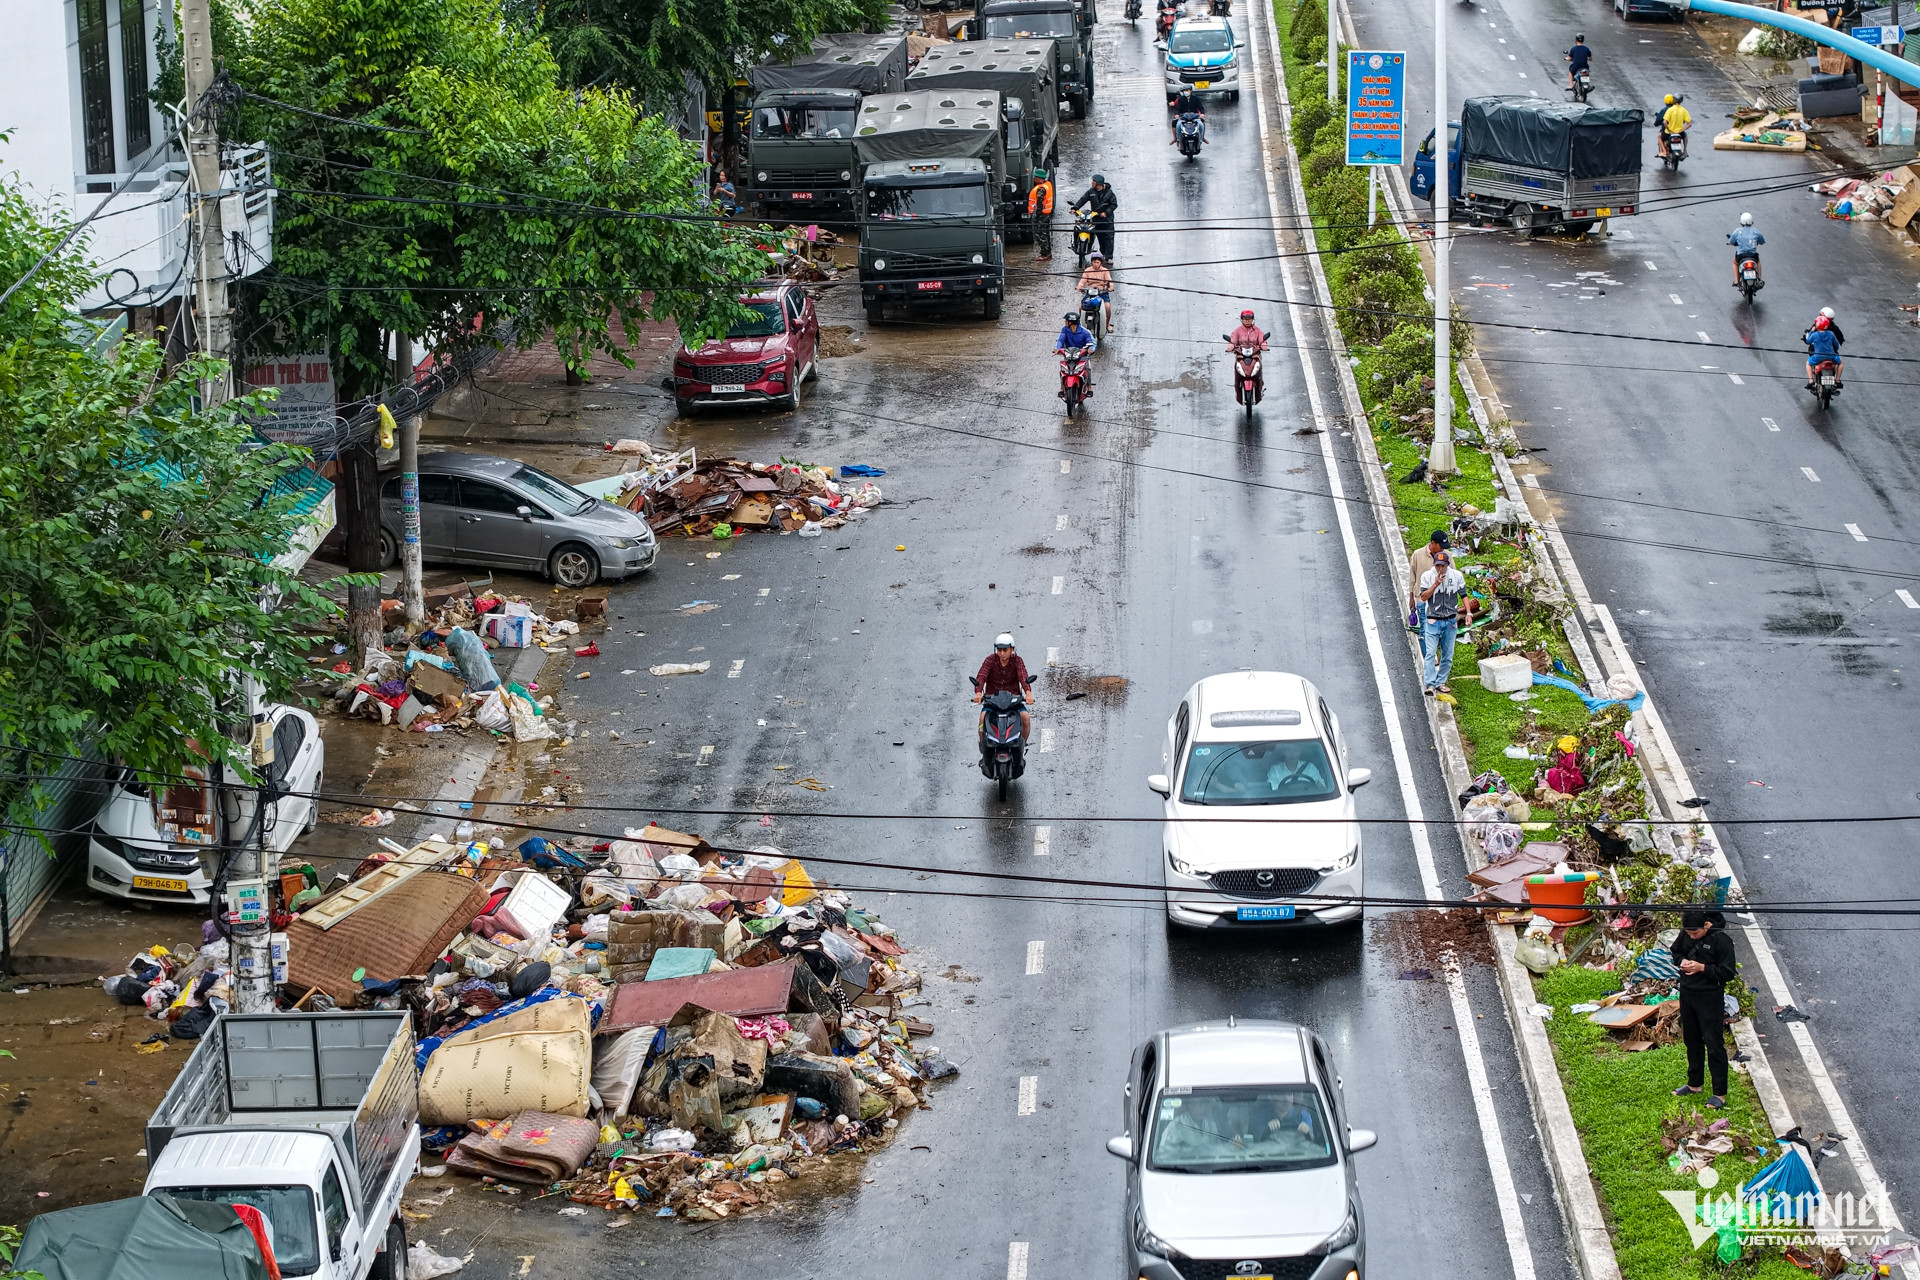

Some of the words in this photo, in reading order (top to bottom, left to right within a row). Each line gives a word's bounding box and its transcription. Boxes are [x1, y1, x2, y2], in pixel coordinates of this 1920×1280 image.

[1358, 97, 1367, 107] 35
[278, 357, 302, 385] THẾ
[305, 363, 329, 384] ANH
[138, 878, 183, 889] 79H-046.75
[1242, 907, 1290, 918] 85A-003.87
[471, 1047, 482, 1069] VICTORY
[432, 1066, 445, 1089] VICTORY
[503, 1065, 513, 1095] VICTORY
